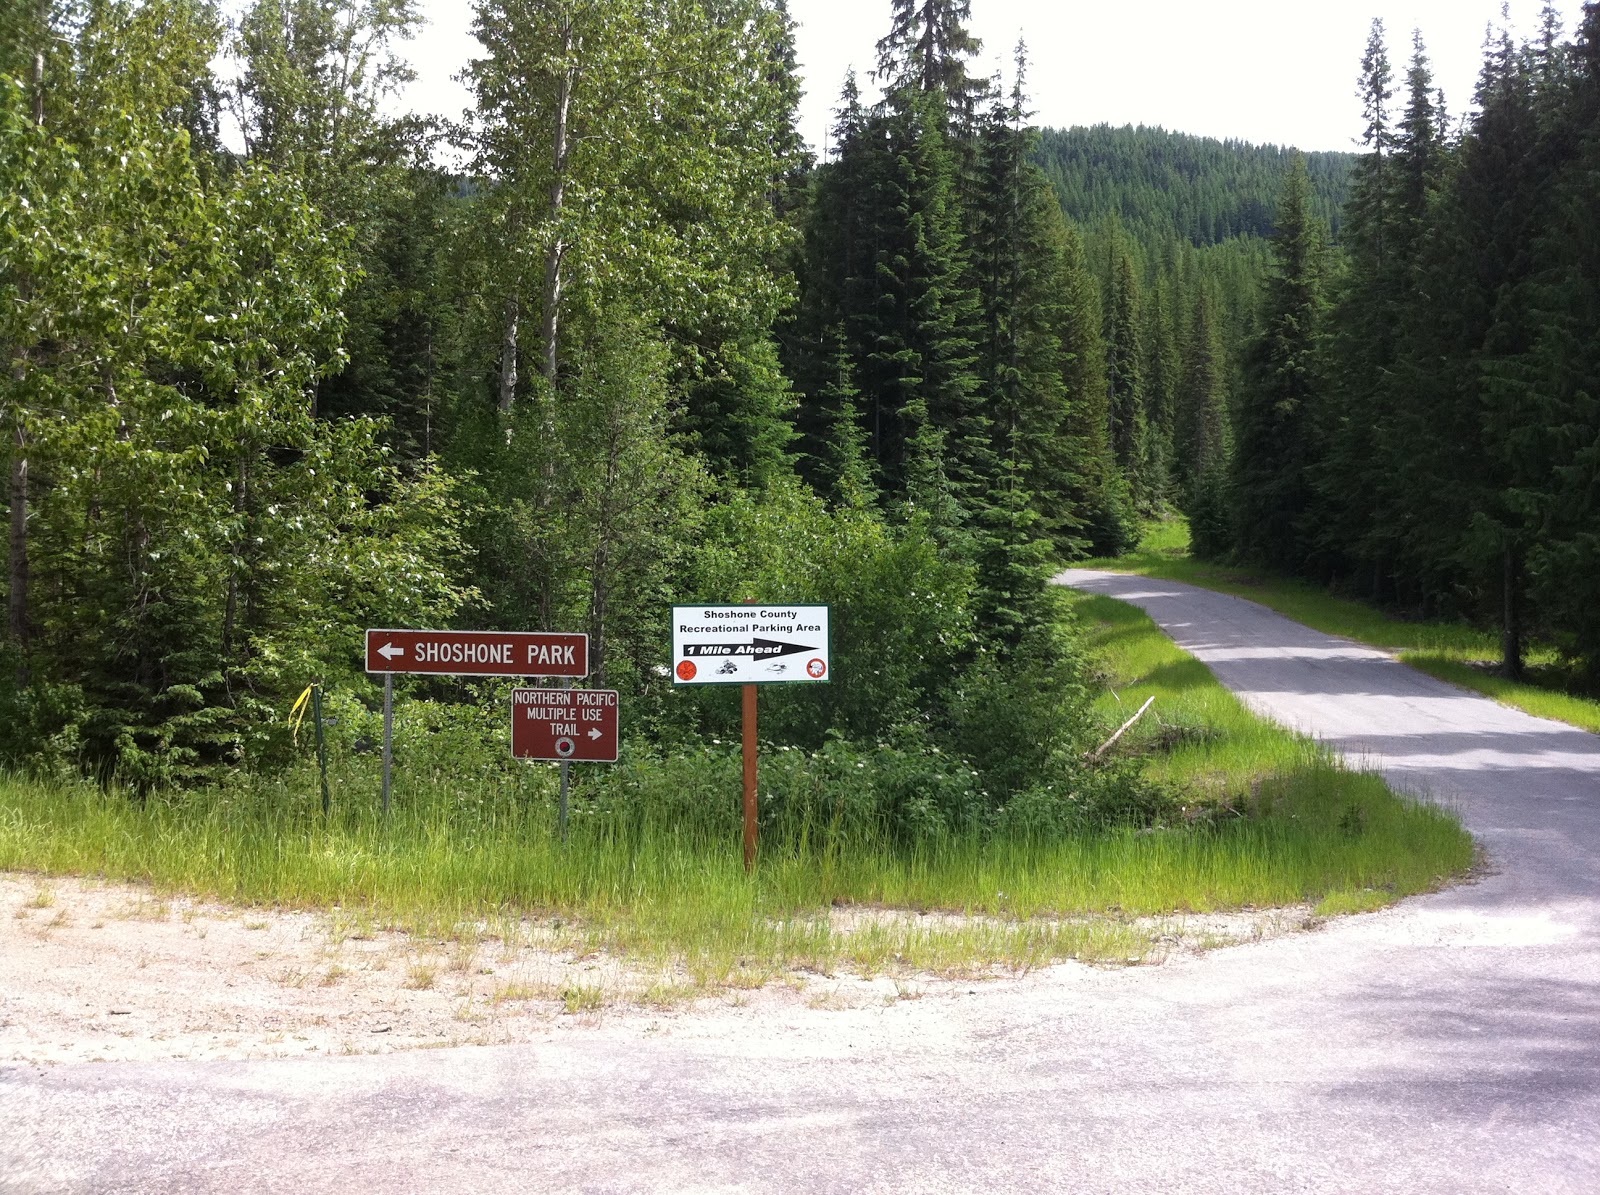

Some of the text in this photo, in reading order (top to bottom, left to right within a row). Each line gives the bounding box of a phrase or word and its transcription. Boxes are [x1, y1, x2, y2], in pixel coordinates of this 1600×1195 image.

[704, 609, 797, 620] Shoshone County
[680, 623, 821, 634] Recreational Parking Area
[415, 642, 575, 665] SHOSHONE PARK
[687, 645, 782, 655] 1 Mile Ahead
[514, 691, 615, 706] NORTHERN PACIFIC
[527, 707, 602, 721] MULTIPLE USE
[550, 723, 580, 736] TRAIL
